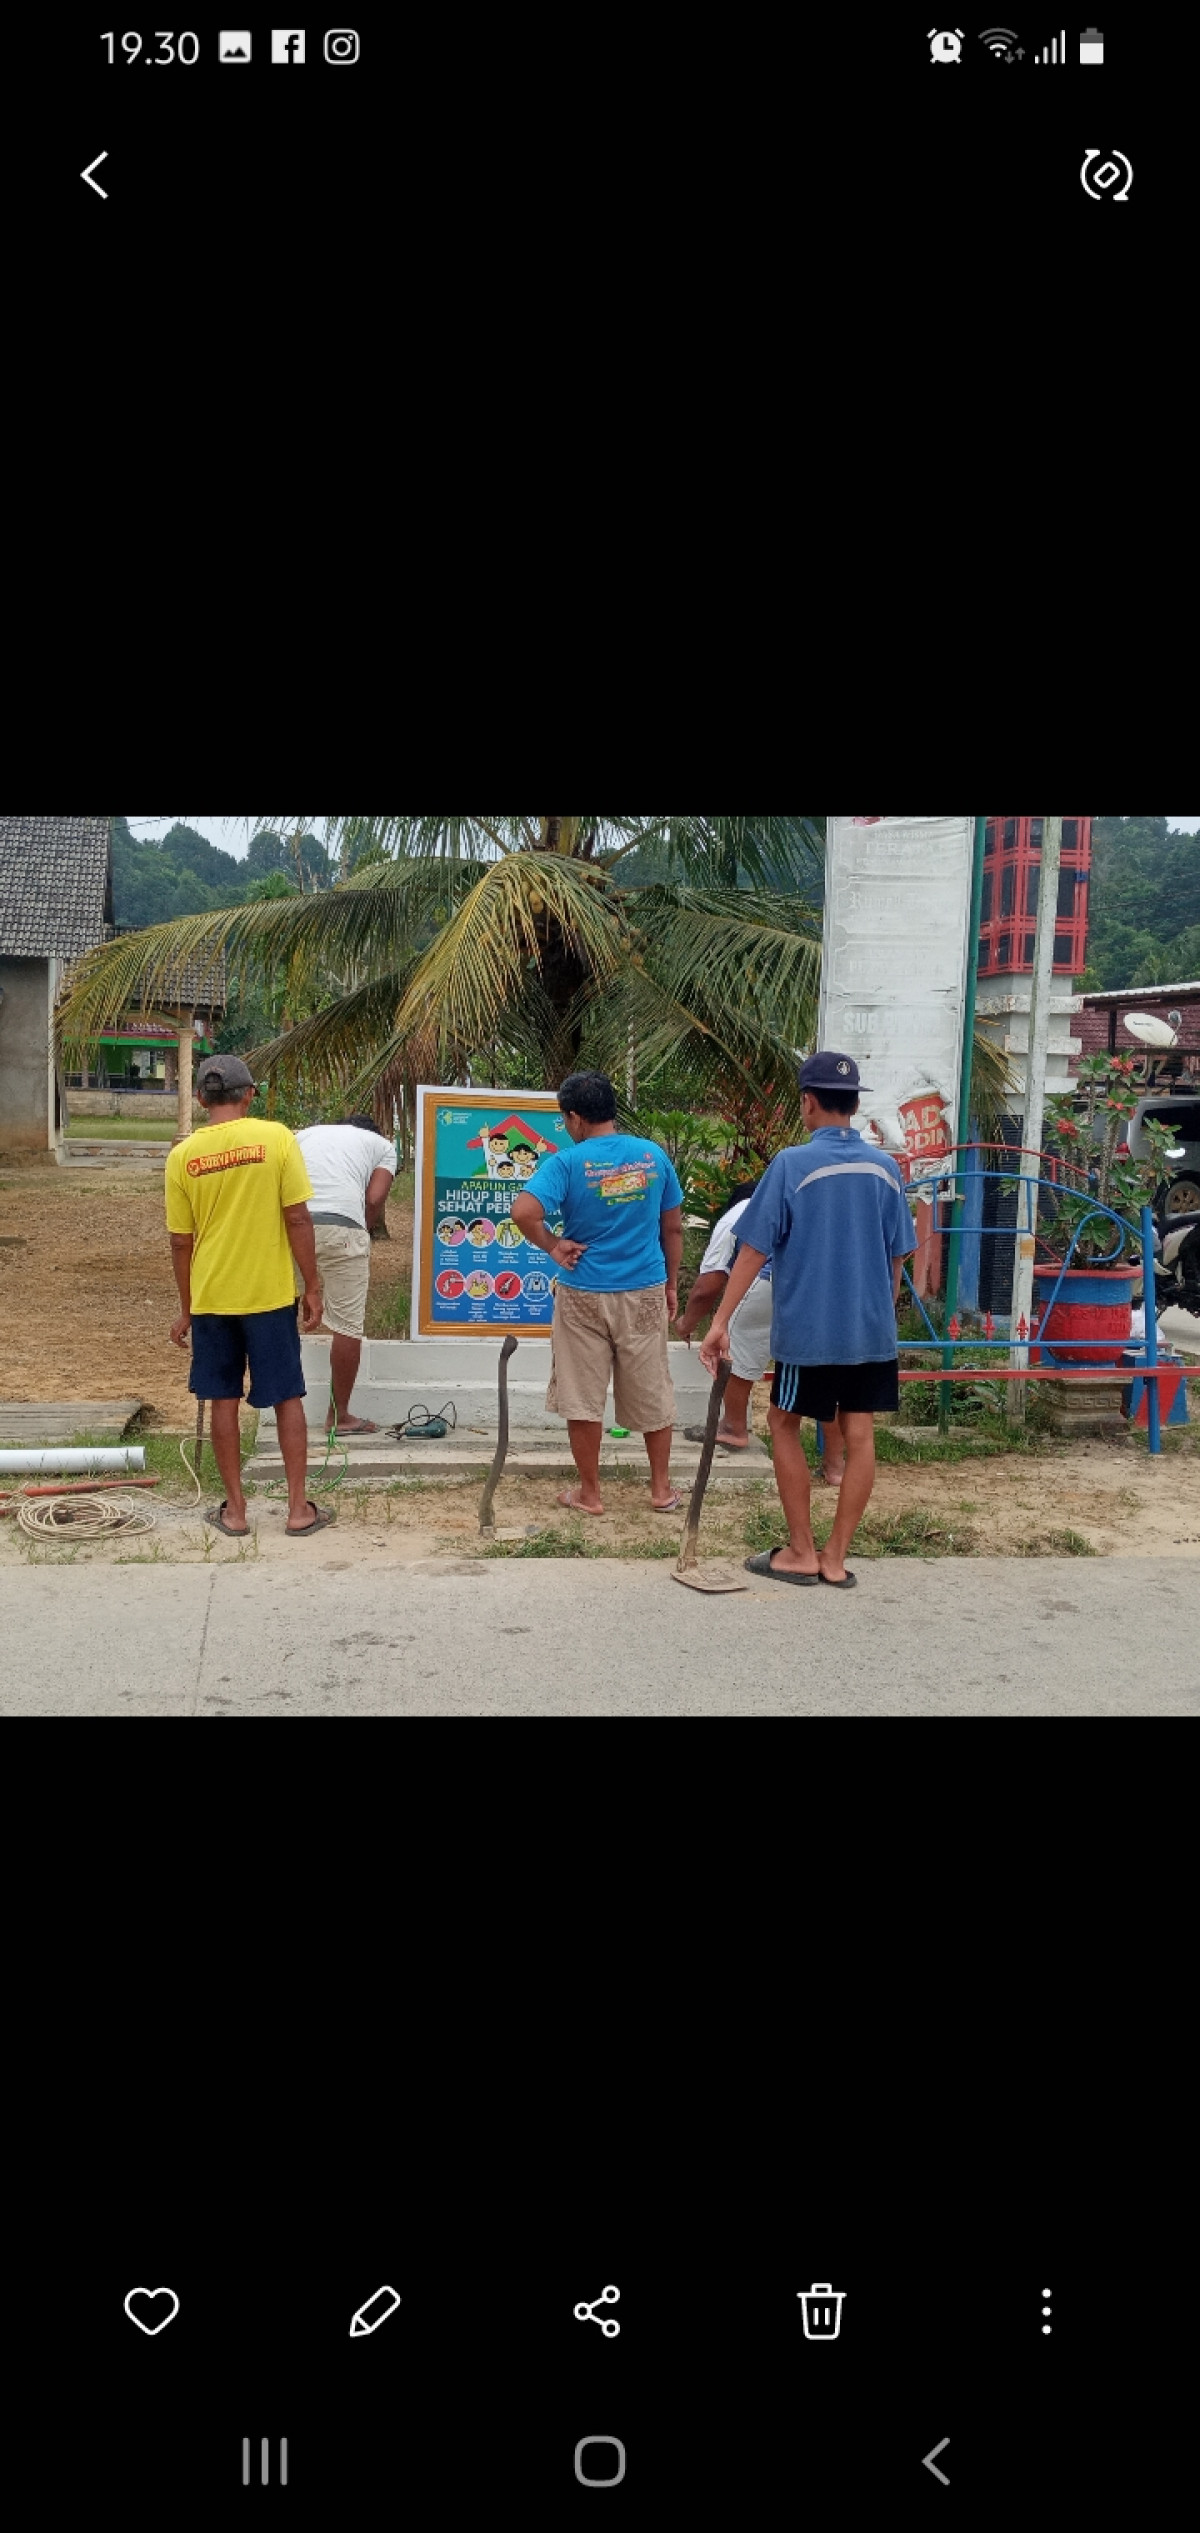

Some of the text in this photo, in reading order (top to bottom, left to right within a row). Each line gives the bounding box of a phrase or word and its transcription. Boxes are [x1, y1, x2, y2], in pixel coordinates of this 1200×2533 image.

[843, 1012, 878, 1034] SUB
[461, 1181, 506, 1191] APAPUN
[446, 1190, 490, 1201] HIDUP
[438, 1200, 483, 1213] SEHAT
